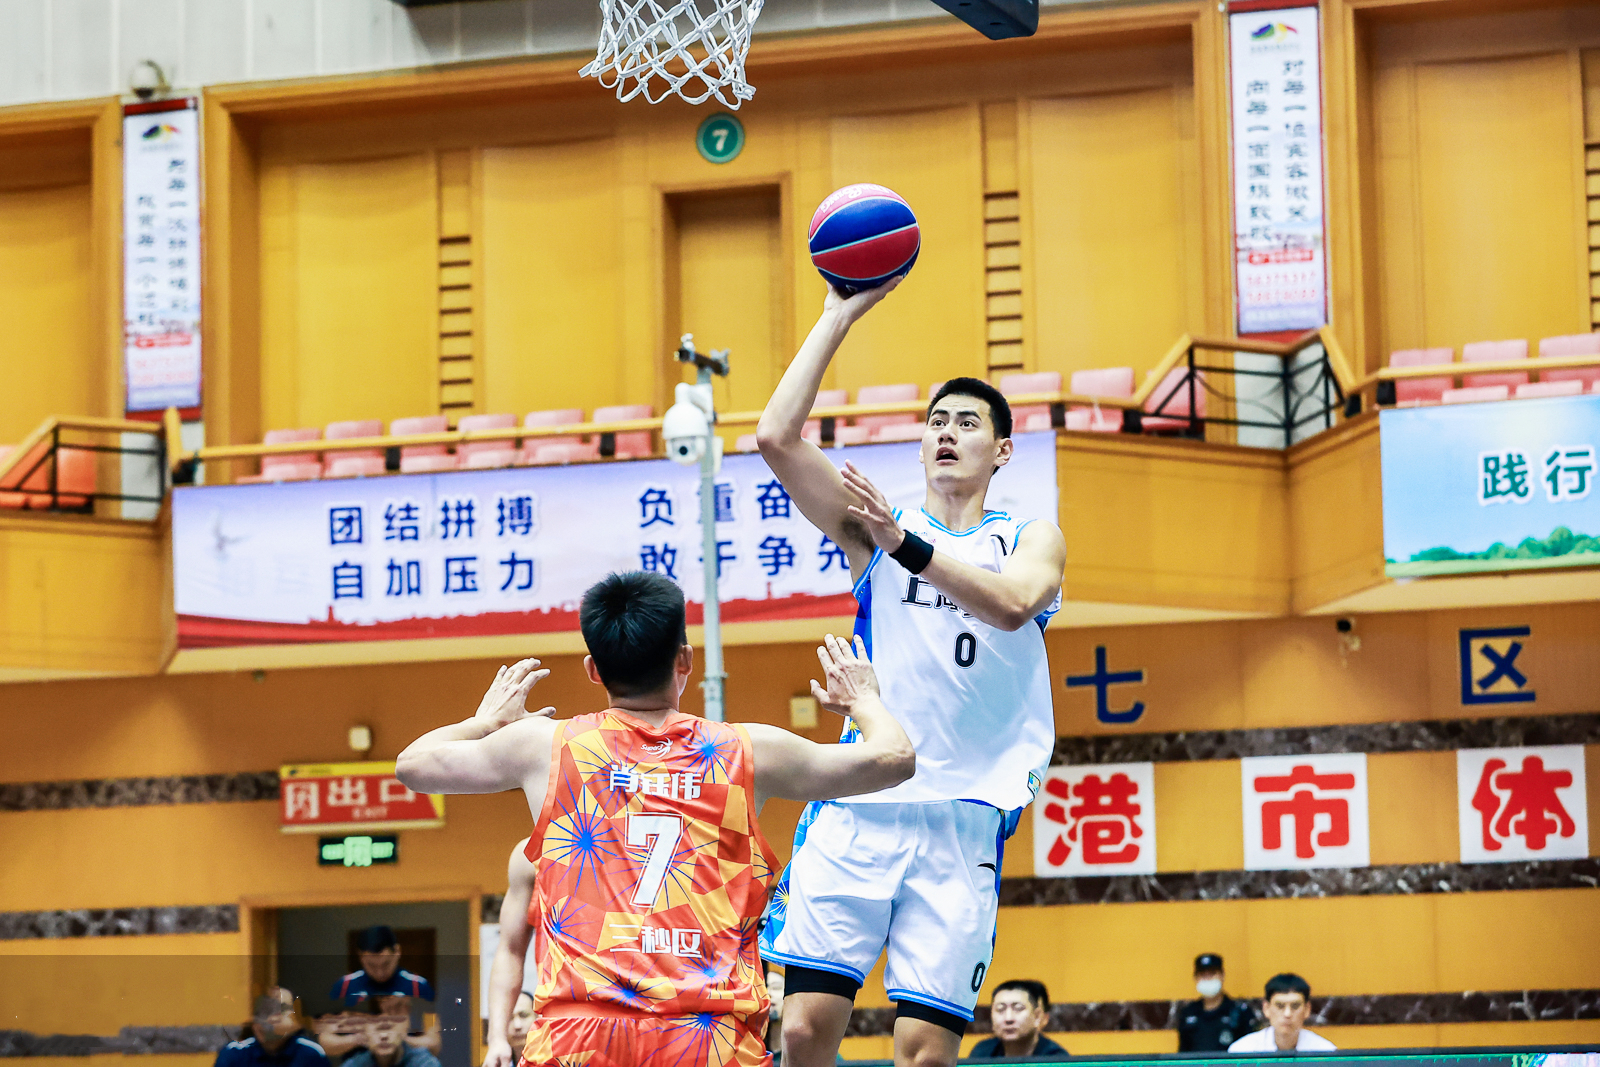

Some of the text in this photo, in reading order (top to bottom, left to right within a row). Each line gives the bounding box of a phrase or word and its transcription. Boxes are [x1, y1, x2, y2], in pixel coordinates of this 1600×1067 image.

[710, 129, 728, 152] 7
[1482, 450, 1593, 499] 践行
[329, 496, 535, 546] 团结拼搏
[332, 552, 535, 600] 自加压力
[953, 631, 977, 668] 0
[609, 764, 701, 801] 肖钰伟
[1044, 755, 1576, 867] 港市体
[625, 811, 684, 908] 7
[609, 923, 702, 958] 三秒区
[970, 962, 985, 993] 0
